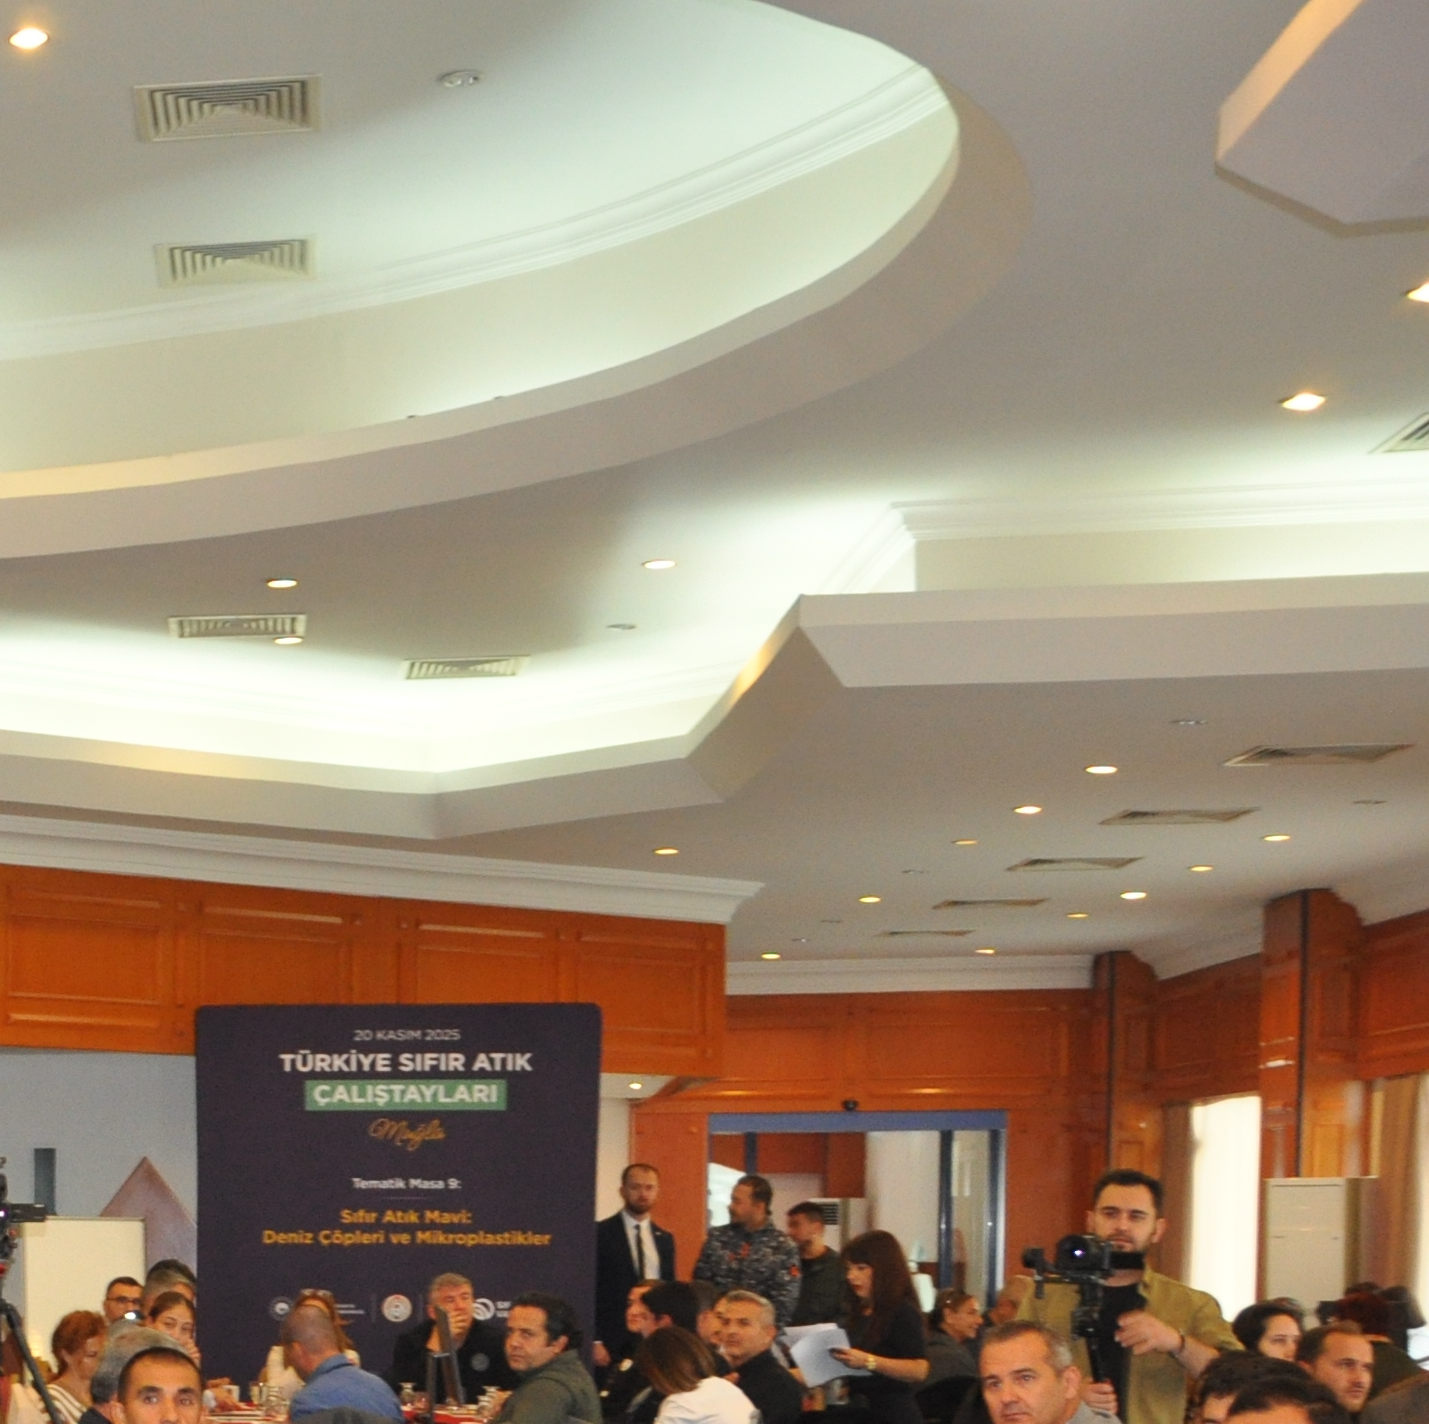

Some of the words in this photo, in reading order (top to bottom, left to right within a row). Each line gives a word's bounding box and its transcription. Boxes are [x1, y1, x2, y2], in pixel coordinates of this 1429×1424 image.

[353, 1030, 373, 1041] 20
[376, 1030, 421, 1041] KASIM
[425, 1029, 461, 1040] 2025
[278, 1050, 392, 1072] TÜRKİYE
[398, 1053, 465, 1071] SIFIR
[472, 1053, 533, 1071] ATIK
[313, 1084, 498, 1106] ÇALIŞTAYLARI
[352, 1177, 406, 1189] Tematik
[409, 1178, 445, 1189] Masa
[339, 1209, 378, 1223] Sıfır
[382, 1209, 420, 1223] Atık
[423, 1209, 473, 1223] Mavi:
[263, 1230, 314, 1244] Deniz
[319, 1230, 385, 1246] Çöpleri
[389, 1232, 411, 1244] ve
[416, 1230, 552, 1247] Mikroplastikler
